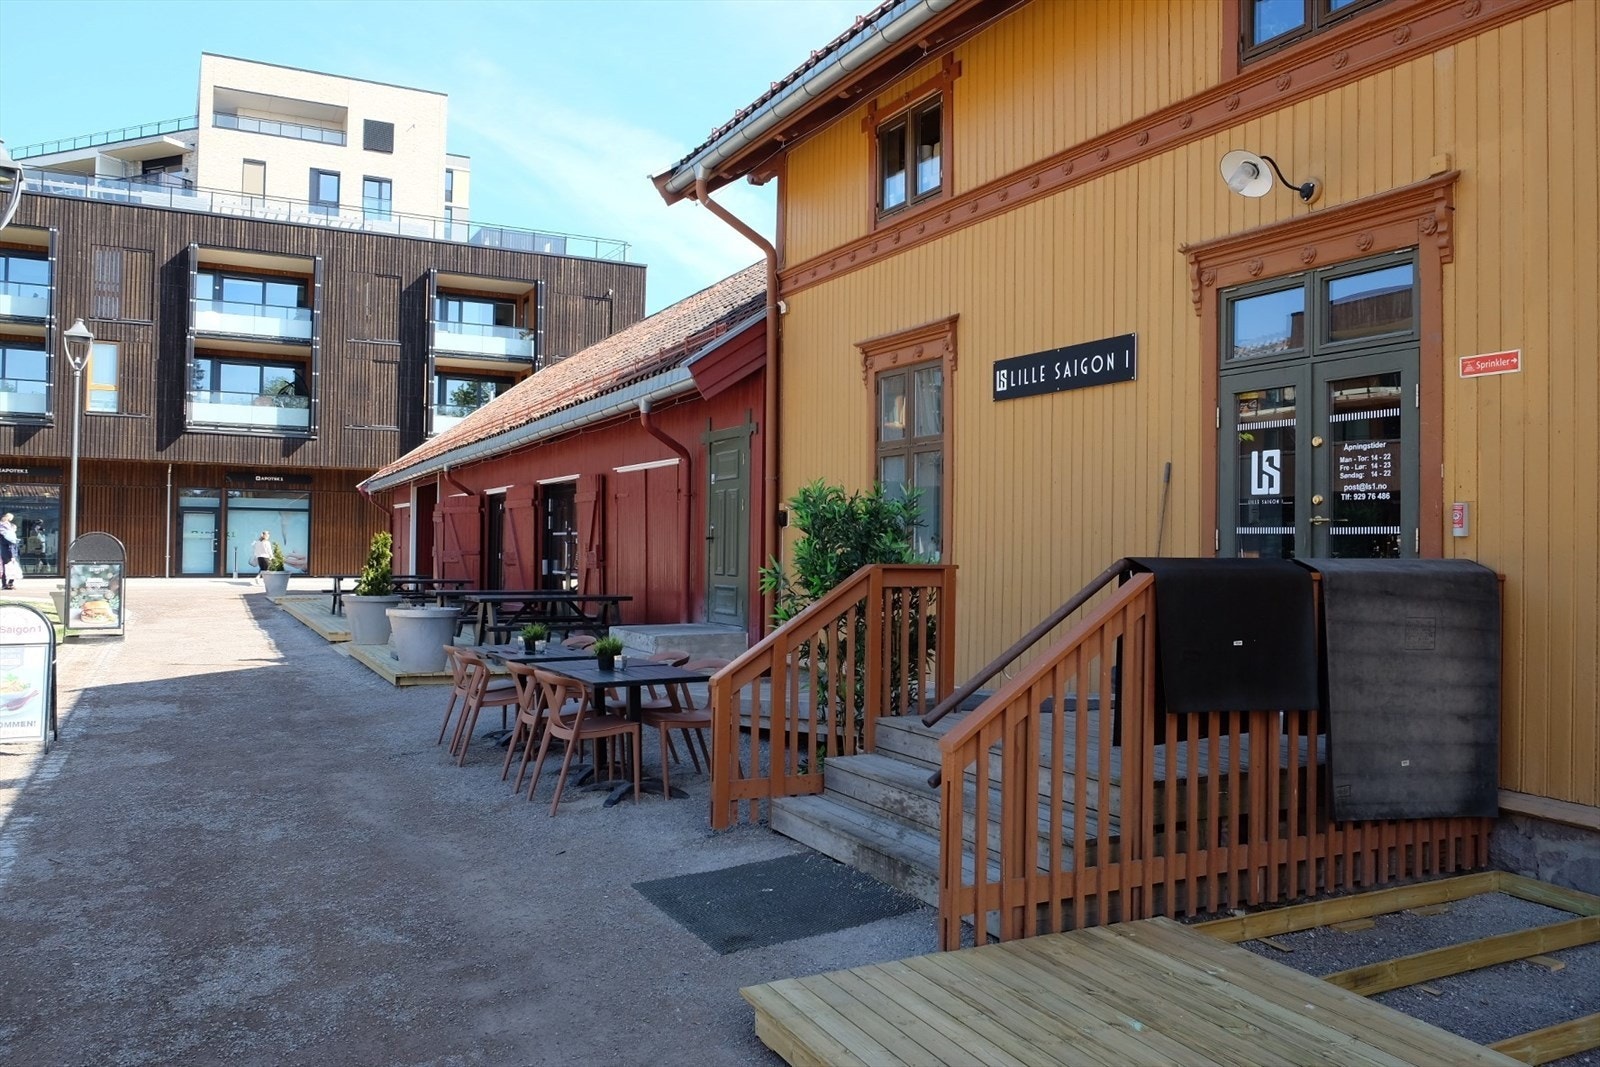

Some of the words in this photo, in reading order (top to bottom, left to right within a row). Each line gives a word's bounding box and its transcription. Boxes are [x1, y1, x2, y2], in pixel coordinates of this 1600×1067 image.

[1011, 365, 1045, 387] LILLE
[1055, 352, 1114, 380] SAIGON
[1476, 358, 1510, 371] Sprinkler
[0, 625, 36, 636] Saigon
